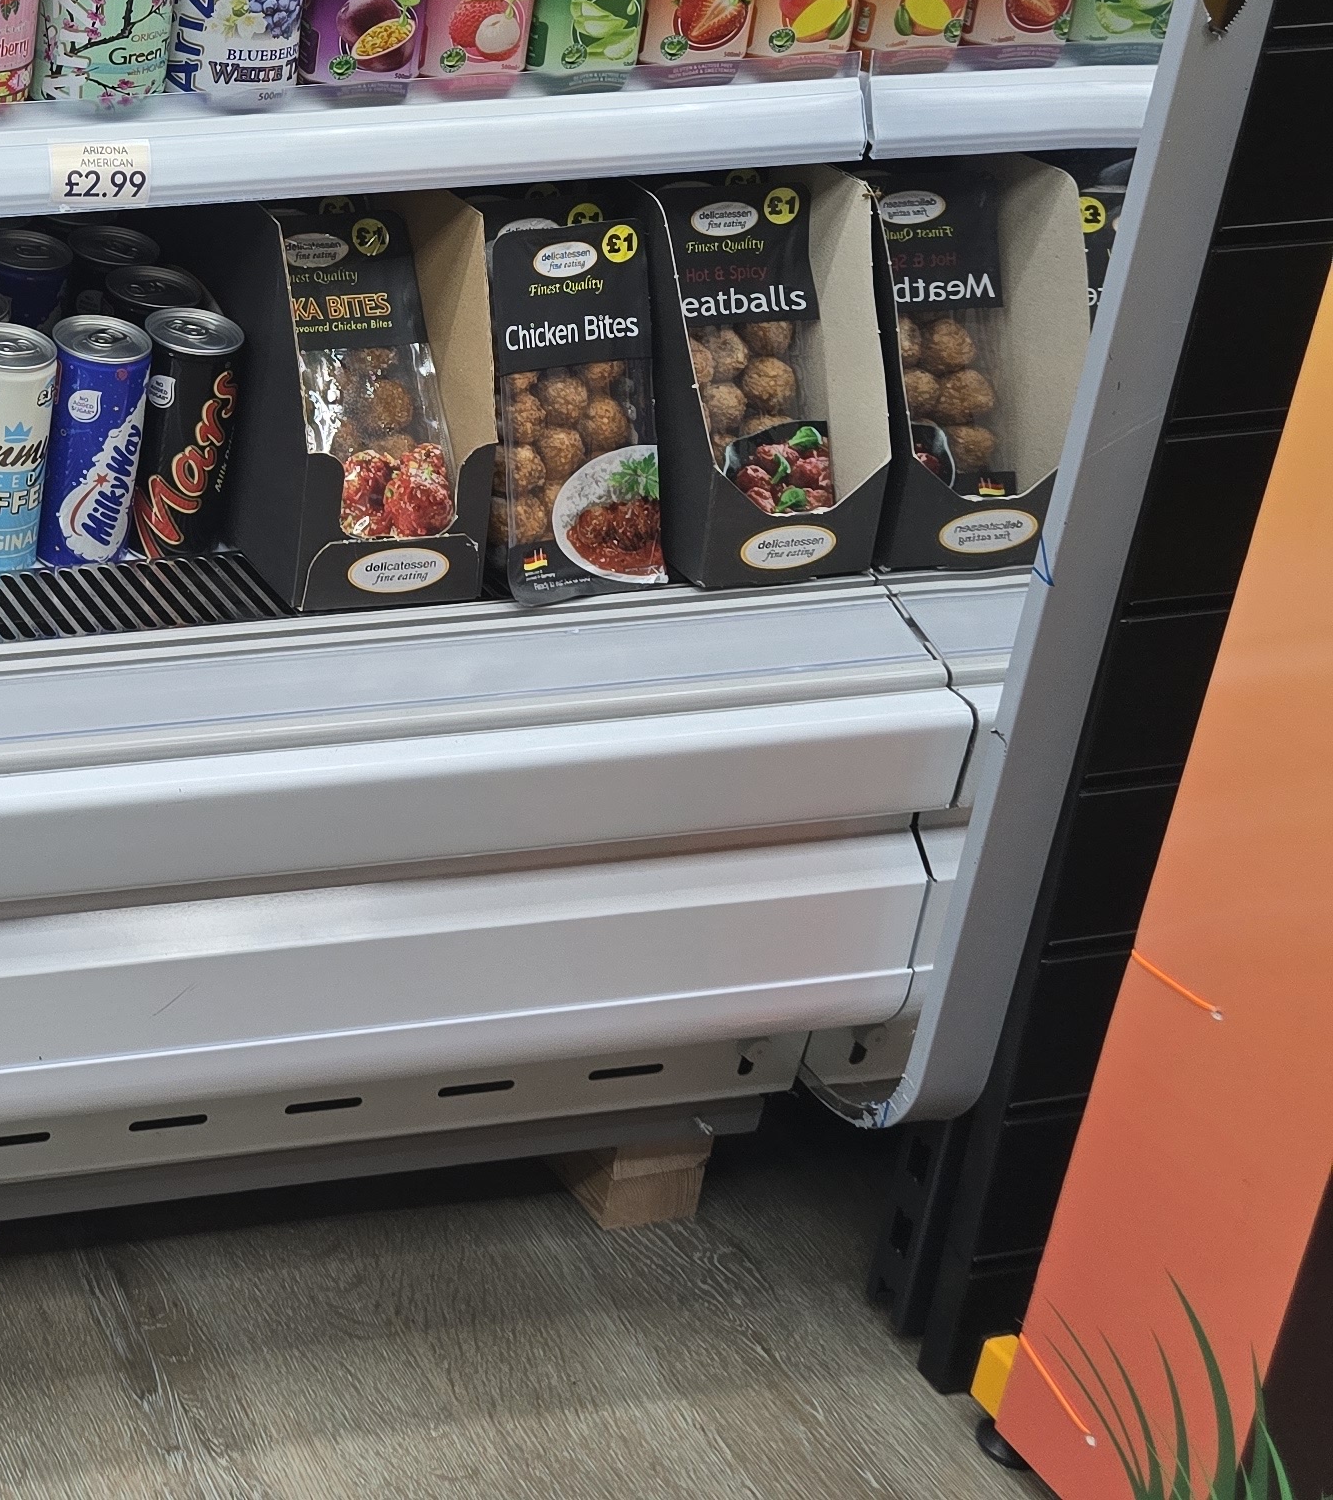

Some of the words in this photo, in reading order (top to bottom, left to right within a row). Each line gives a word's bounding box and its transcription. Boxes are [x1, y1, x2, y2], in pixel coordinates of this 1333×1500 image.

[83, 147, 128, 155] ARIZONA
[80, 158, 133, 168] AMERICAN
[65, 170, 146, 198] £2.99
[607, 233, 634, 254] £1
[686, 268, 711, 282] Hot
[715, 267, 725, 280] &
[729, 265, 767, 282] Spicy
[529, 282, 559, 296] Finest
[563, 278, 603, 294] Quality
[327, 293, 391, 319] BITES
[683, 285, 807, 318] eatballs
[332, 321, 367, 330] Chicken
[370, 319, 392, 329] Bites
[506, 324, 579, 351] Chicken
[584, 315, 639, 341] Bites
[365, 558, 436, 571] delicatessen
[376, 571, 398, 583] fine
[401, 570, 428, 582] eating
